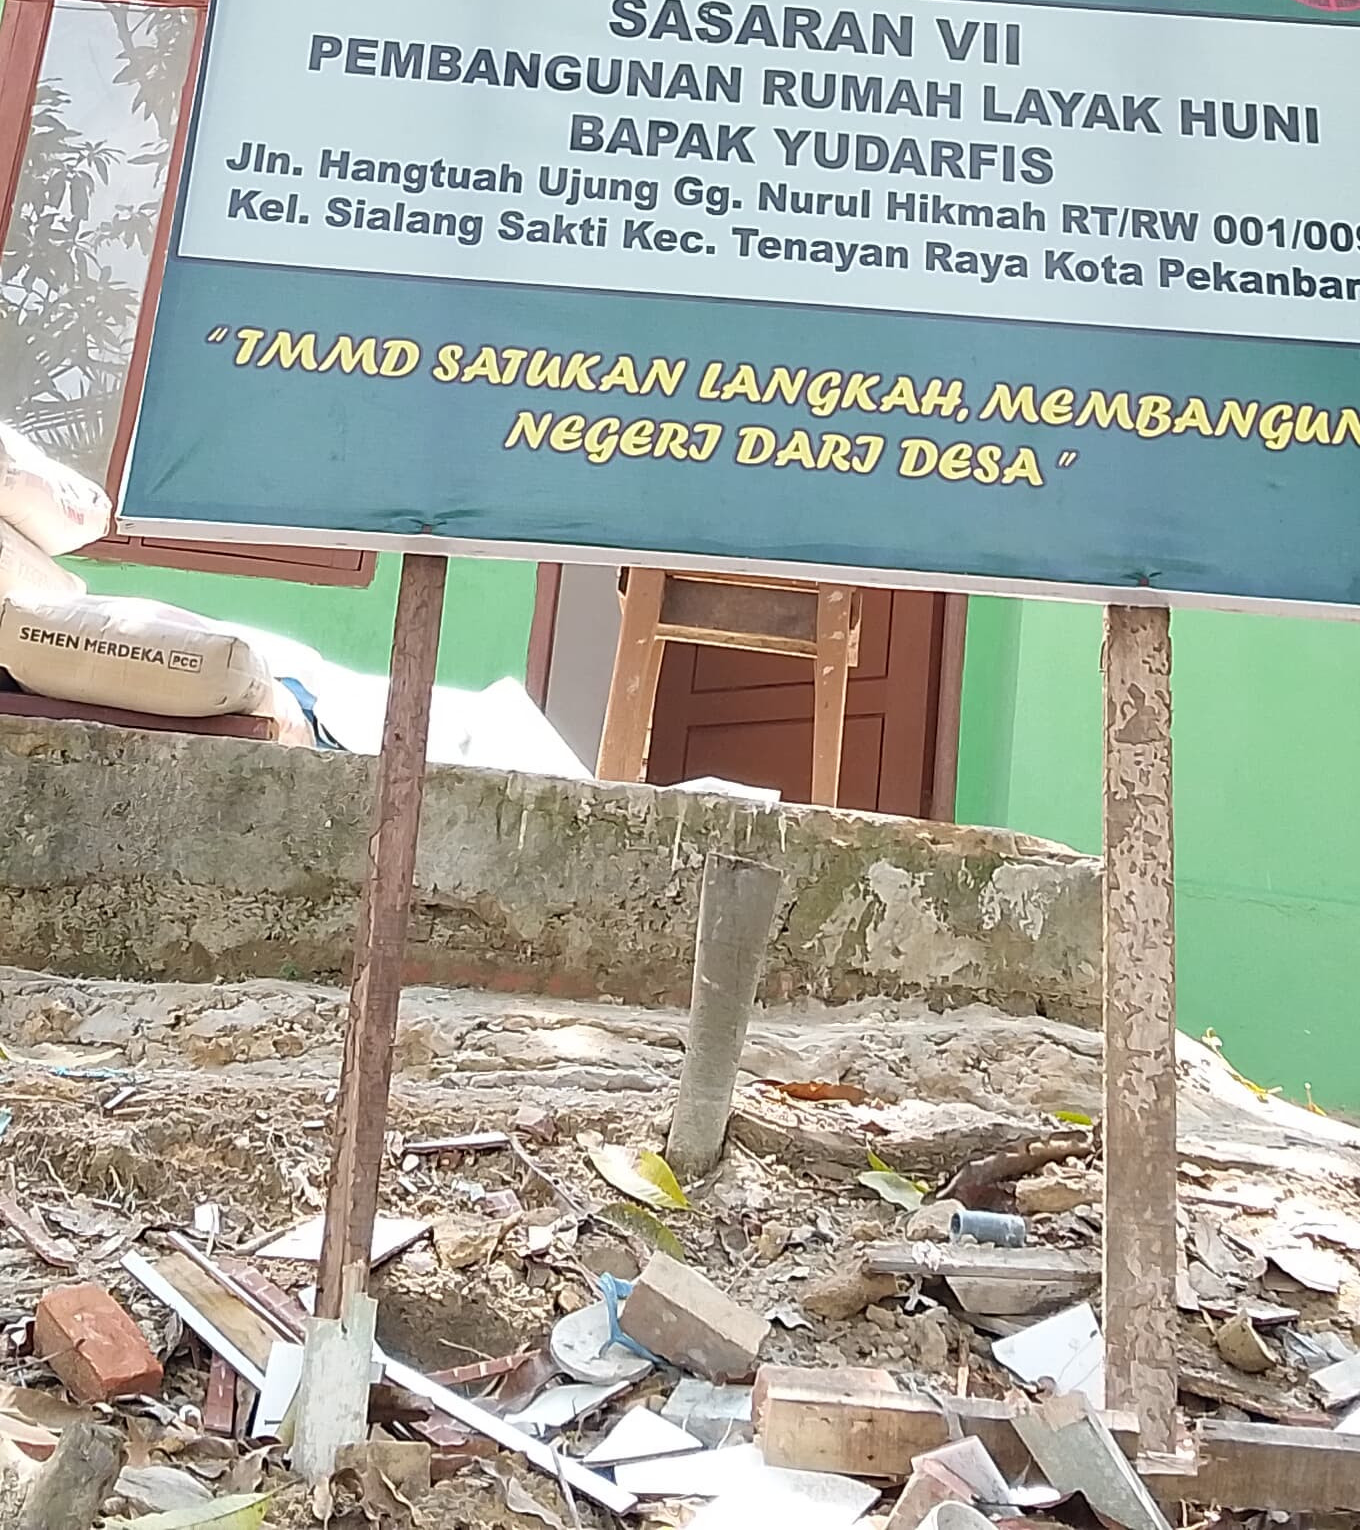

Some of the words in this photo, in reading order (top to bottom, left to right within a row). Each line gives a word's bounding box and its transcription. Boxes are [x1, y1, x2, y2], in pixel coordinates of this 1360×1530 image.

[937, 20, 1021, 66] VII
[309, 35, 740, 103] PEMBANGUNAN
[763, 70, 962, 120] RUMAH
[983, 85, 1161, 133] LAYAK
[1180, 99, 1319, 144] HUNI
[570, 114, 755, 164] BAPAK
[775, 128, 1054, 185] YUDARFIS
[226, 142, 302, 176] Jln.
[320, 150, 522, 194] Hangtuah
[539, 168, 658, 209] Ujung
[674, 177, 741, 214] Gg.
[759, 182, 870, 220] Nurul
[886, 193, 1046, 233] Hikmah
[1062, 205, 1198, 242] RT/RW
[227, 189, 308, 224] Kel.
[325, 198, 483, 244] Sialang
[498, 212, 606, 248] Sakti
[624, 220, 716, 255] Kec.
[733, 228, 909, 278] Tenayan
[925, 243, 1028, 281] Raya
[1045, 251, 1143, 287] Kota
[433, 344, 686, 396] SATUKAN
[700, 362, 970, 422] LANGKAH,
[899, 438, 1044, 486] DESA
[19, 626, 80, 650] SEMEN
[84, 637, 165, 665] MERDEKA
[172, 655, 200, 668] PCC
